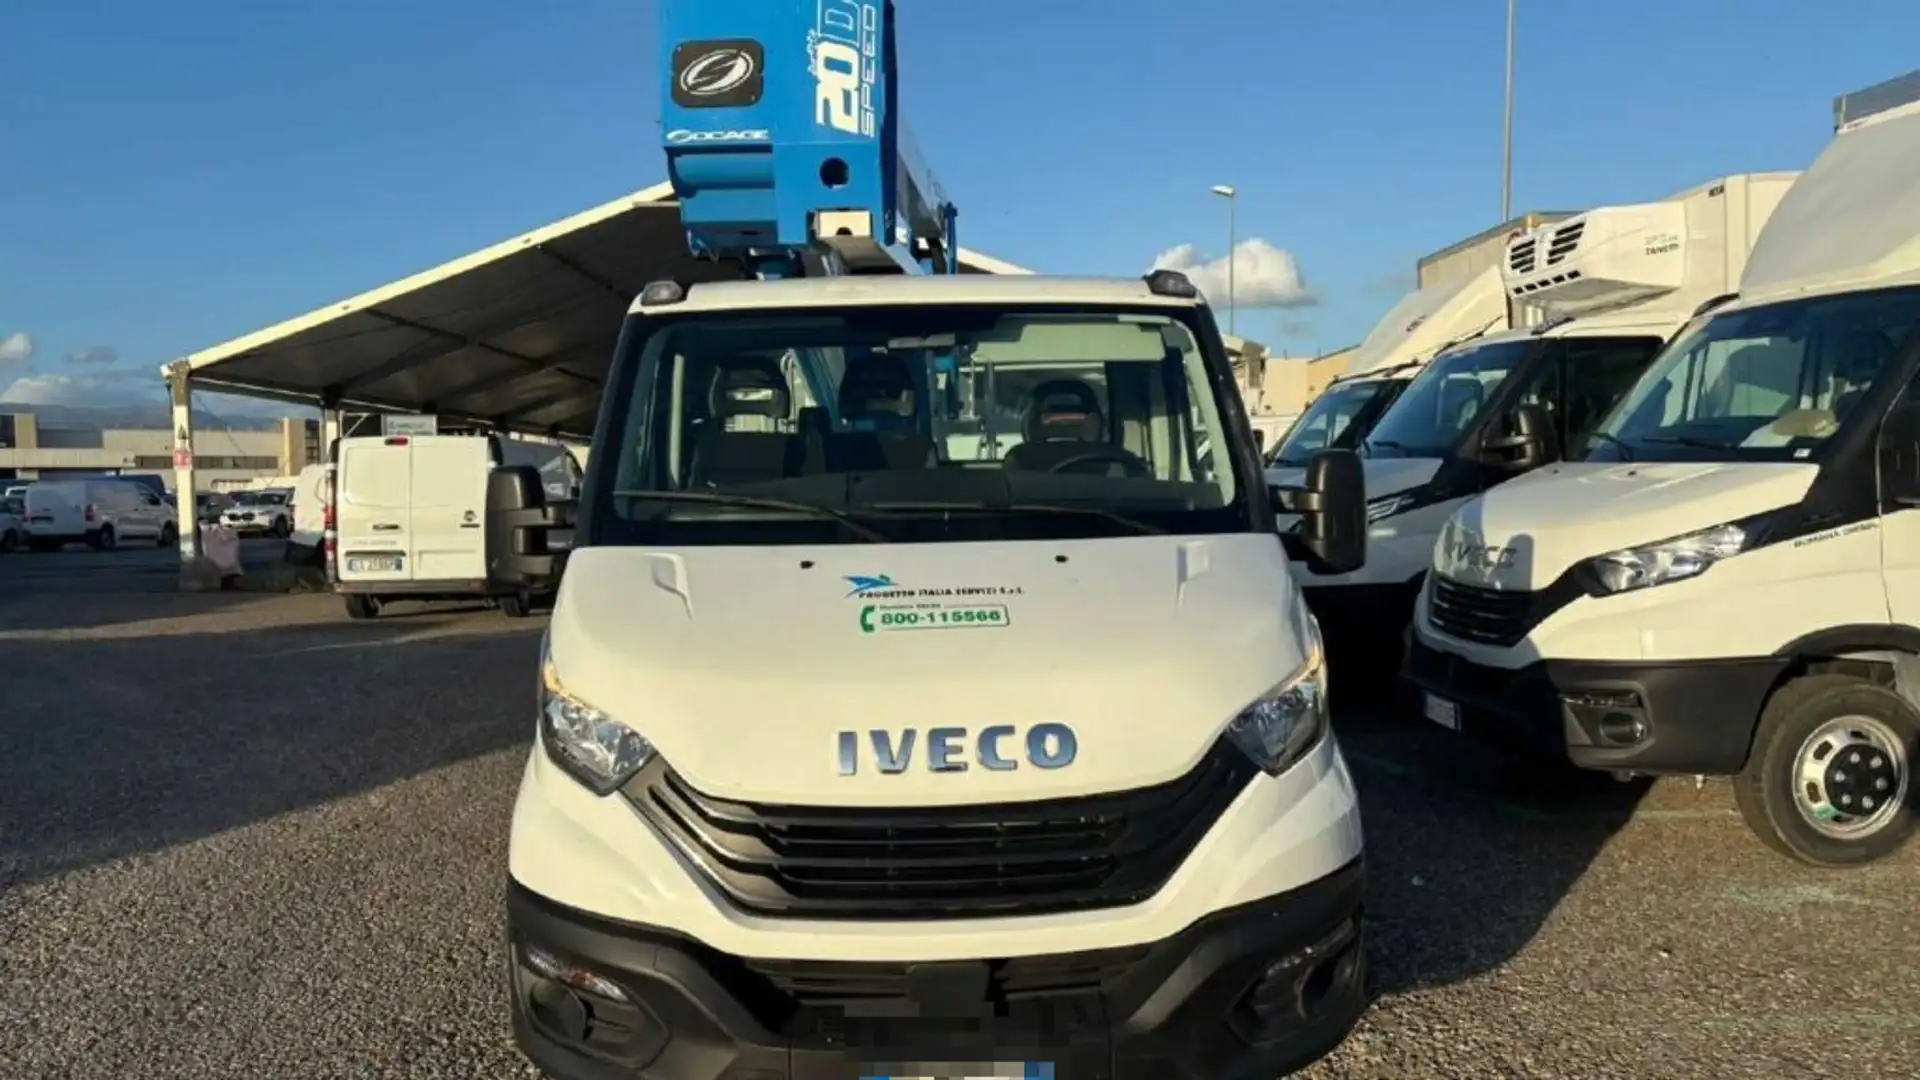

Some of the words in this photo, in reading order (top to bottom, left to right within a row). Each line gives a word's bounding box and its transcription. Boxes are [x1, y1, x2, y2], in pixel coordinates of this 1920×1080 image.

[861, 4, 876, 138] SPEED
[858, 589, 916, 599] PROGETTO
[918, 588, 953, 597] ITALIA
[955, 587, 997, 596] SERVIZI
[880, 609, 1001, 625] 800-115566
[837, 722, 1078, 776] IVECO
